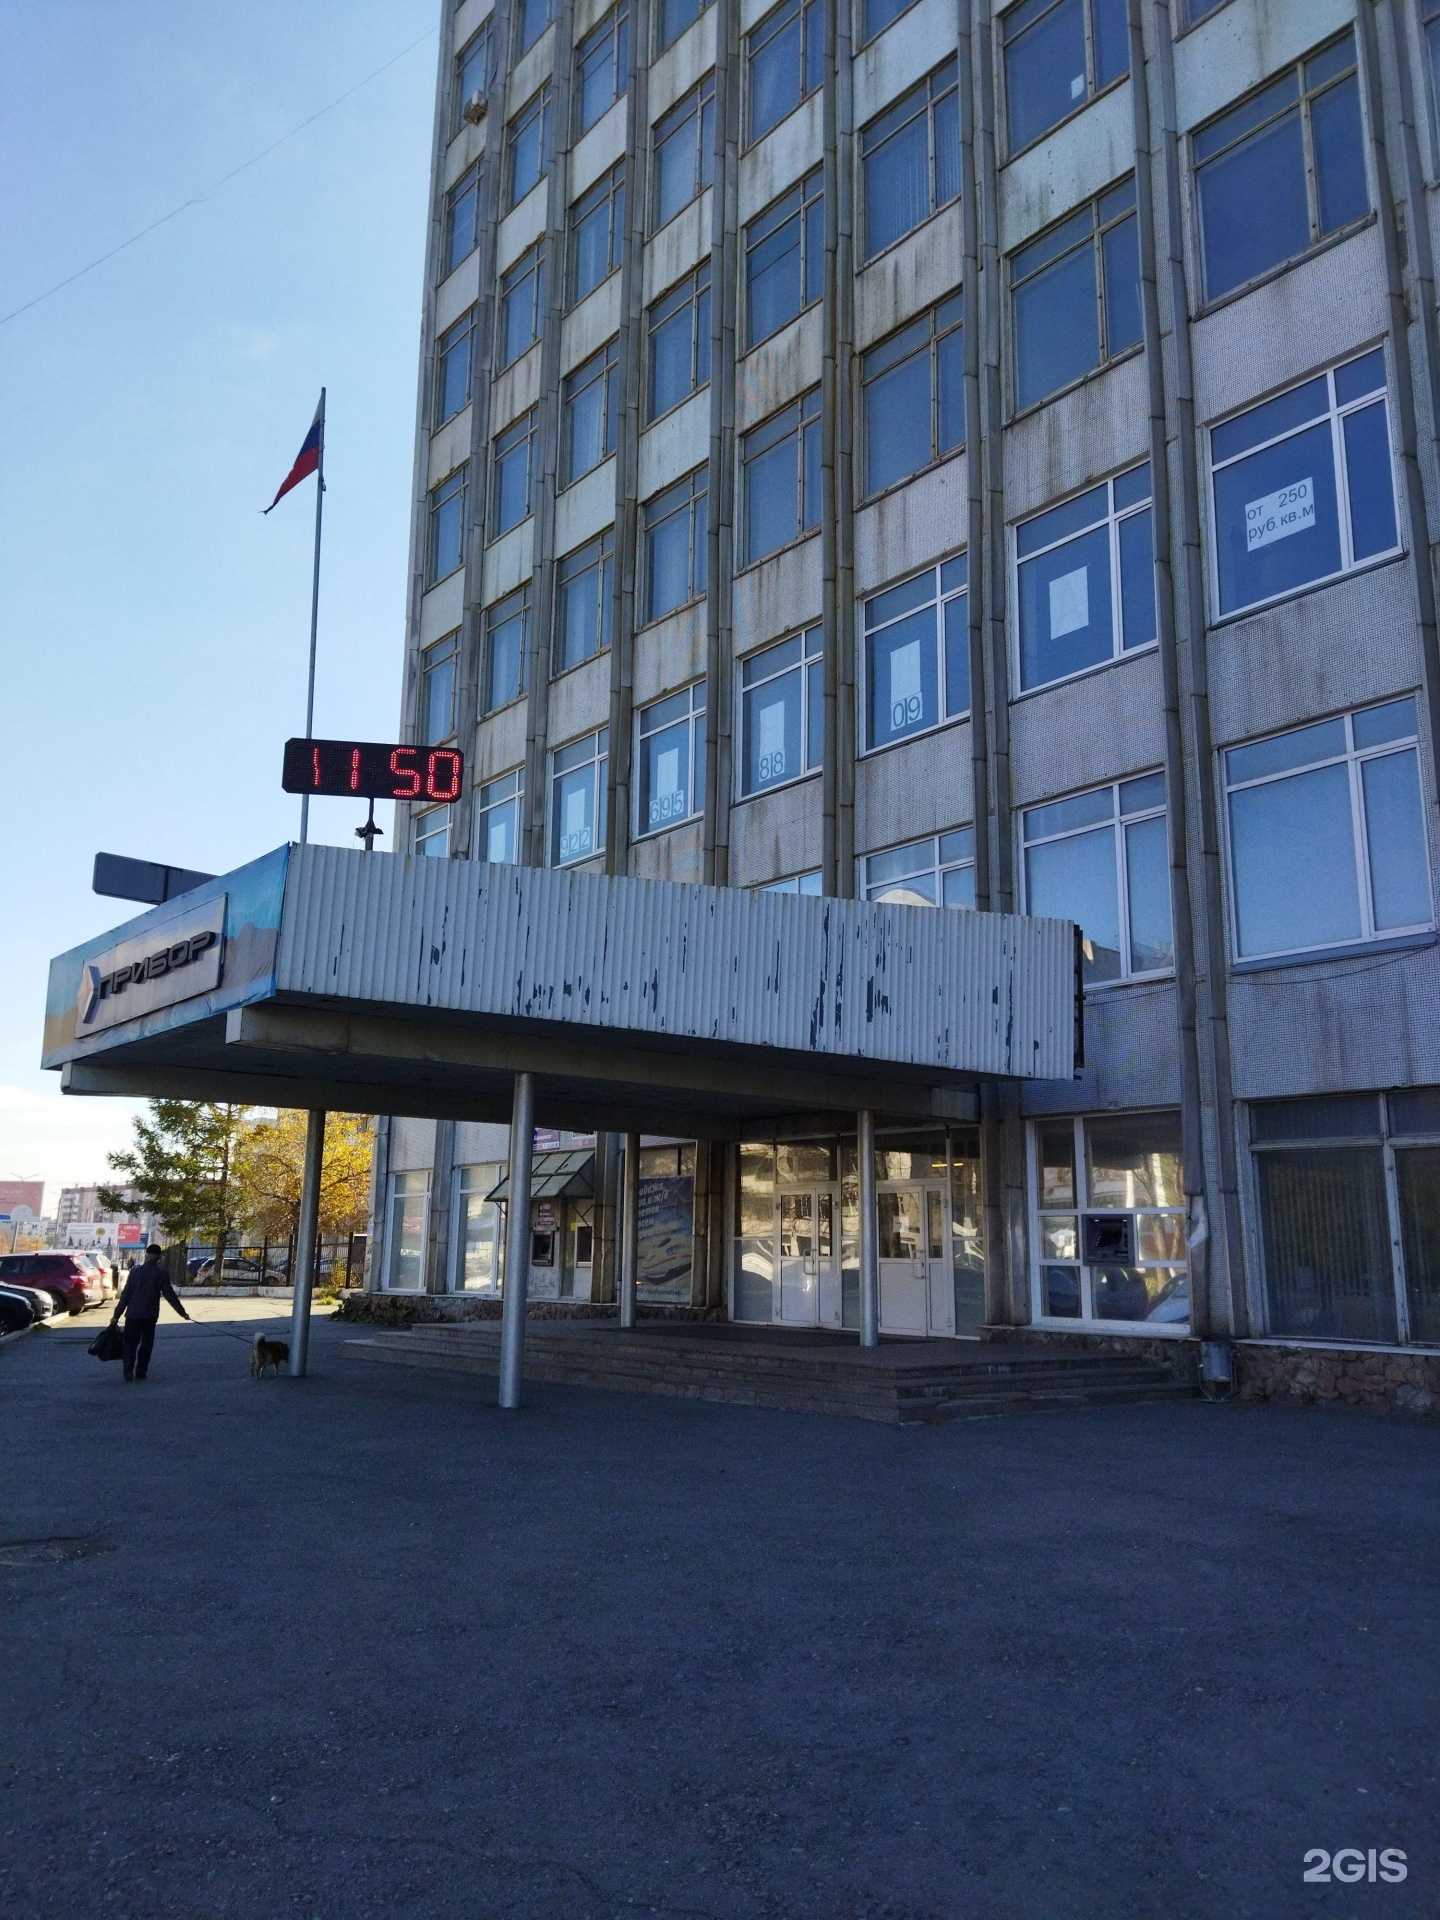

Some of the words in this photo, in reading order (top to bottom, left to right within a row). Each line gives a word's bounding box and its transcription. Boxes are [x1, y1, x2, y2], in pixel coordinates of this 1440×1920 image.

[1247, 504, 1264, 521] от
[1278, 484, 1307, 508] 250
[99, 931, 216, 999] ПРИБОР
